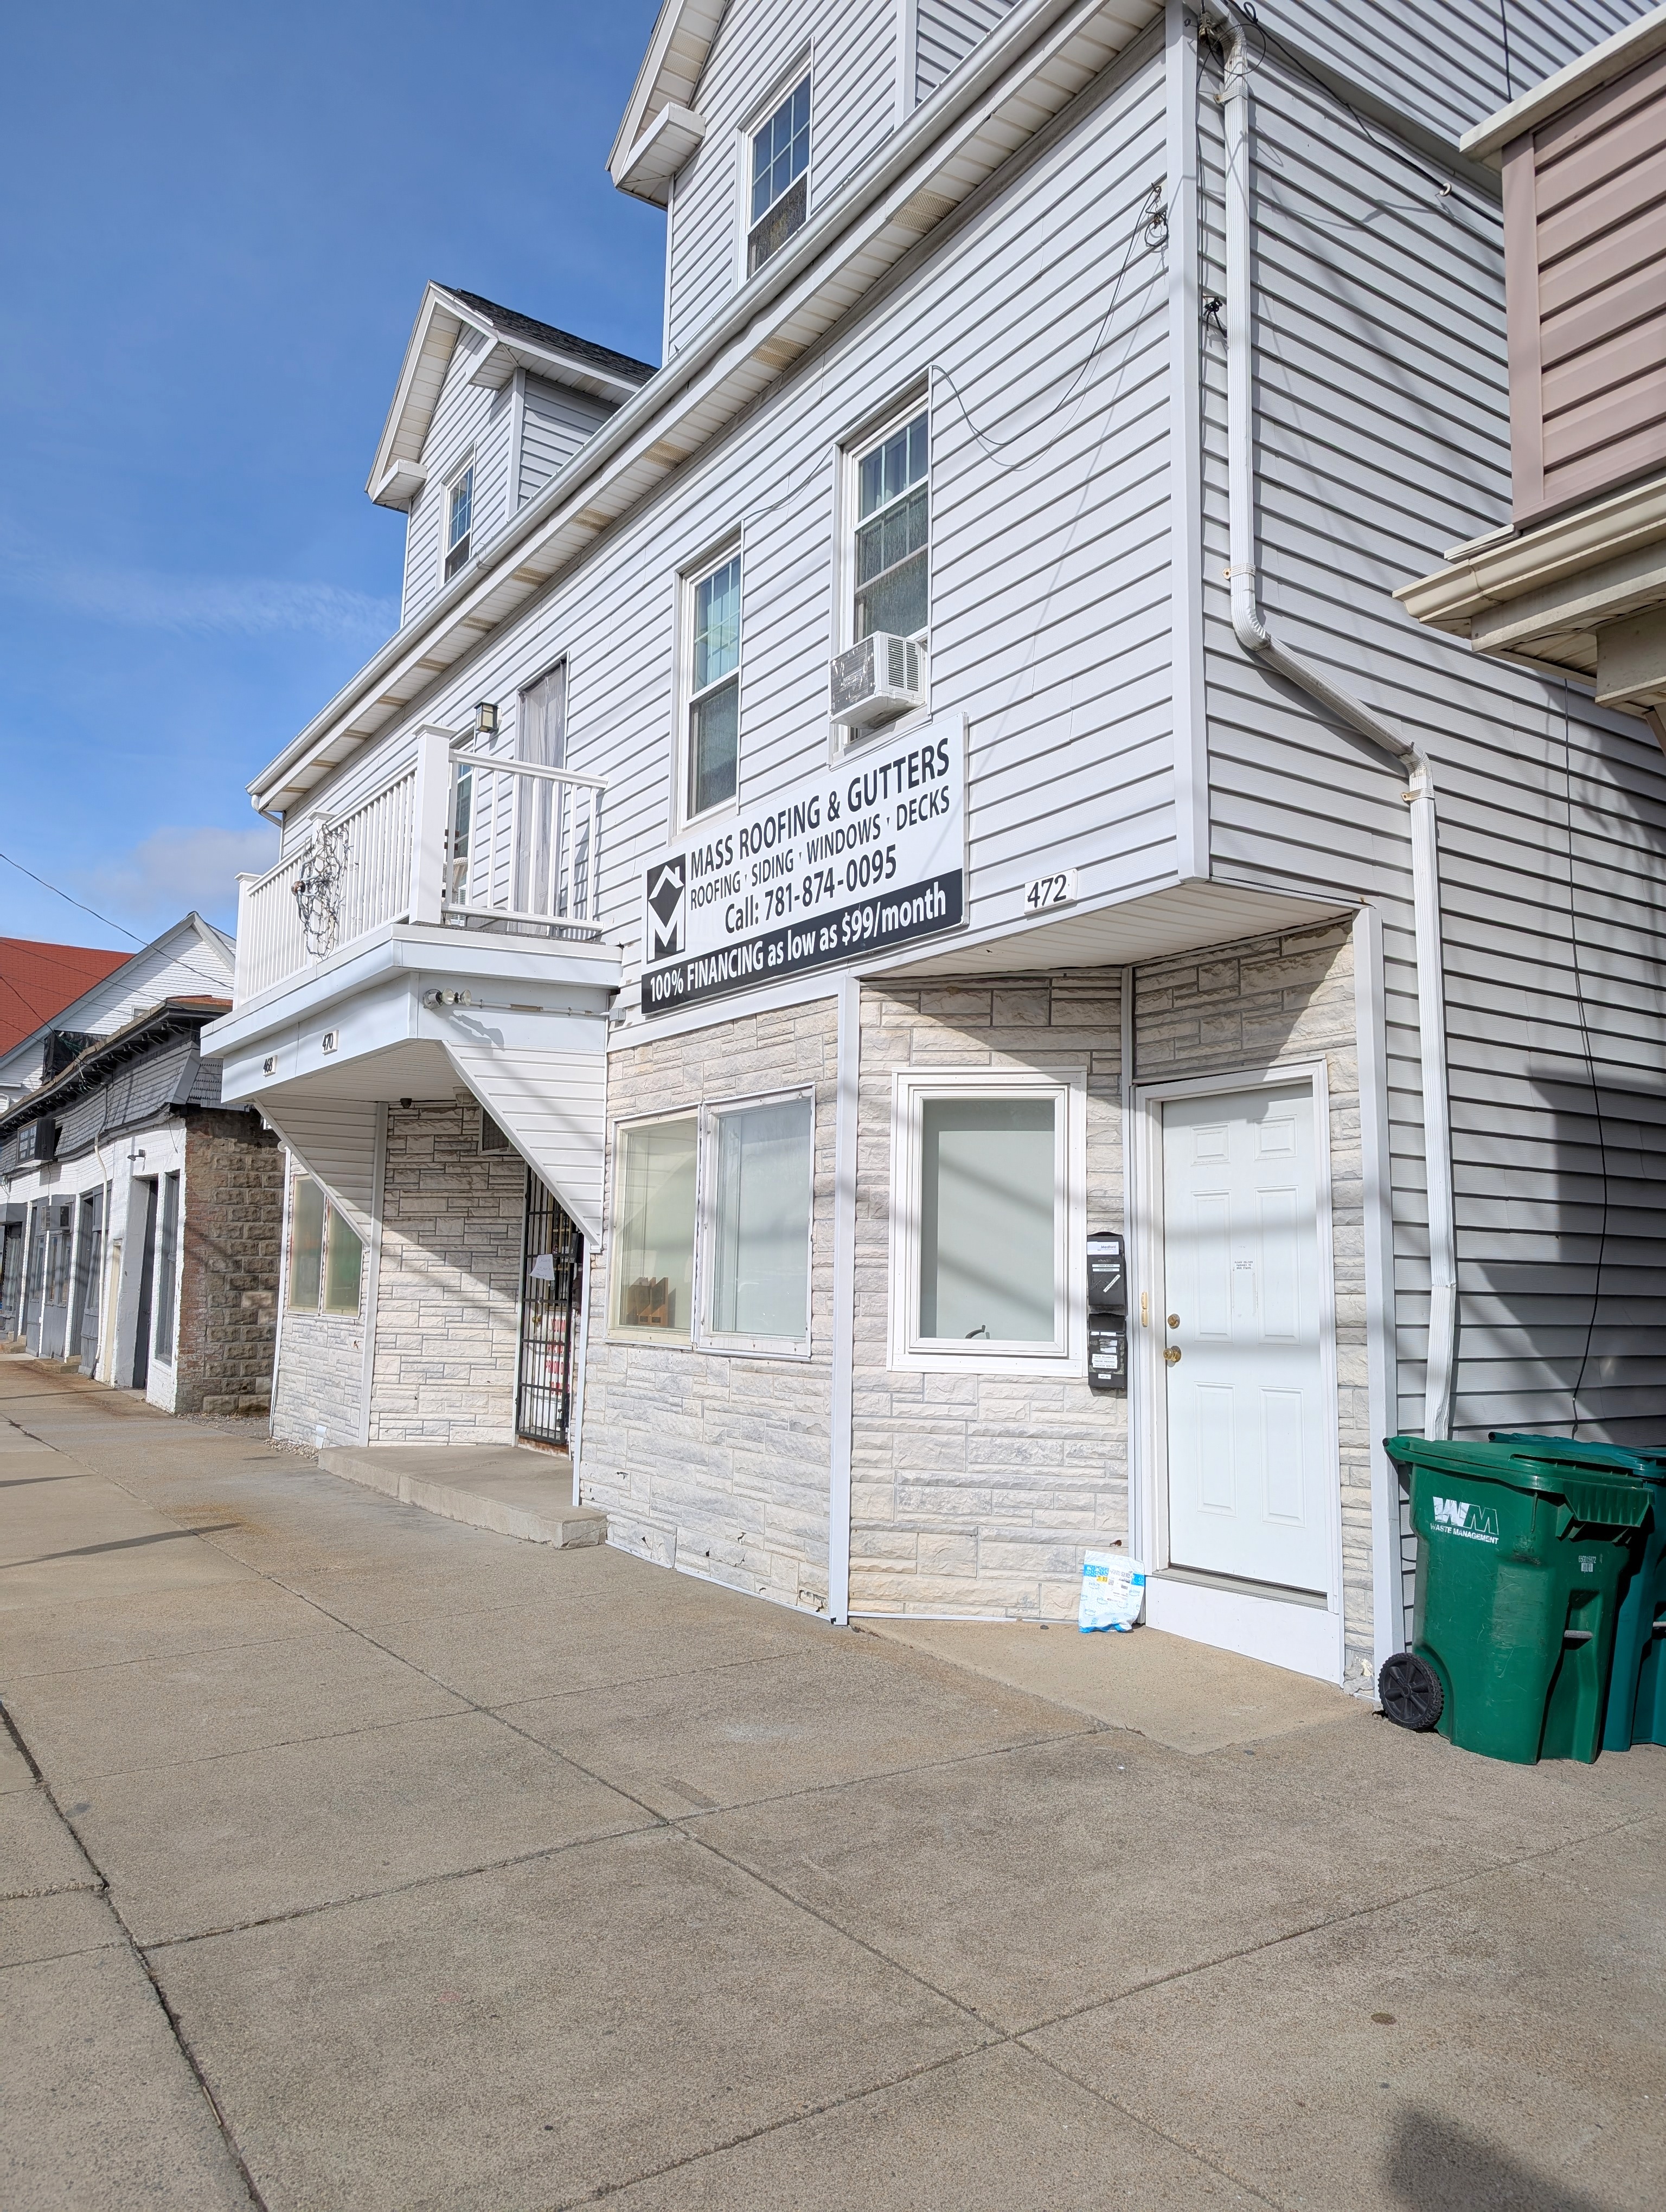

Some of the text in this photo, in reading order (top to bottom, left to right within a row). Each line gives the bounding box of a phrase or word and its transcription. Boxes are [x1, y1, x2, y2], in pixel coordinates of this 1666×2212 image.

[690, 737, 950, 881] MASS ROOFING & GUTTERS
[690, 785, 950, 911] ROOFING SIDING WINDOWS DECKS
[725, 844, 896, 934] Call: 781-874-0095
[1027, 874, 1067, 909] 472
[650, 881, 946, 1002] 100% FINANCING as low as $99/month
[322, 1032, 334, 1051] 470
[263, 1057, 273, 1074] 468
[1430, 1522, 1500, 1545] WASTE MANAGEMENT
[1432, 1496, 1500, 1536] WM
